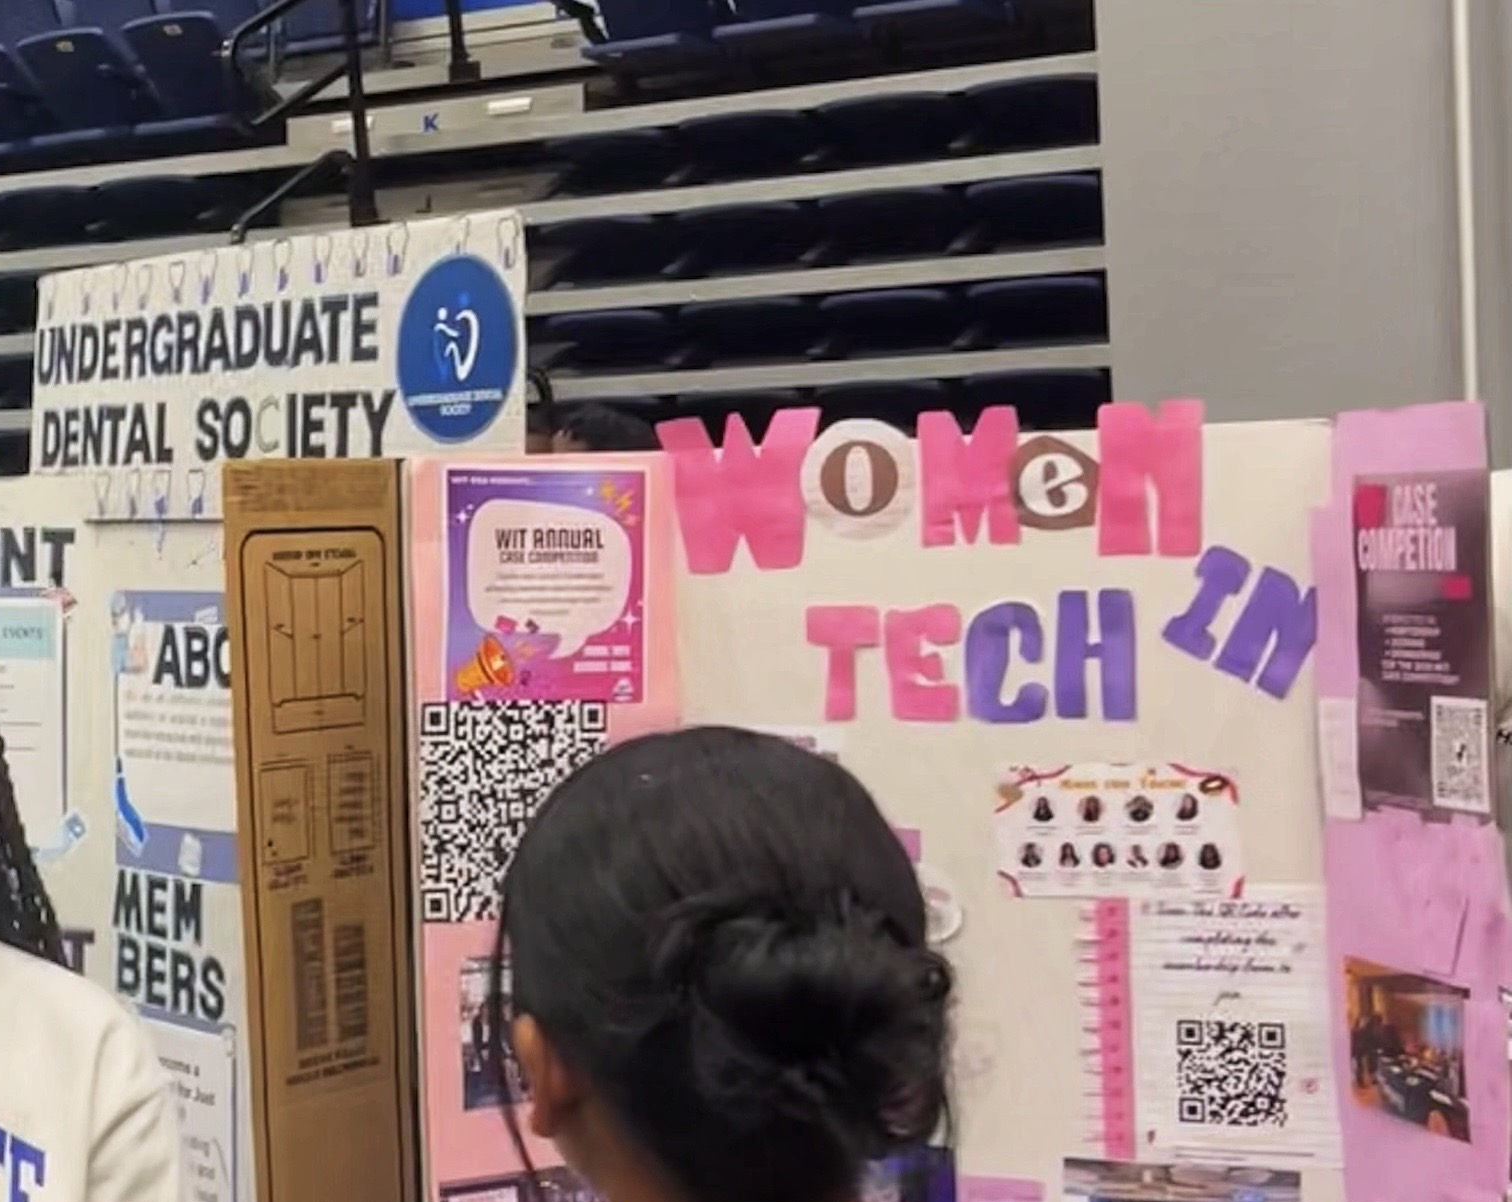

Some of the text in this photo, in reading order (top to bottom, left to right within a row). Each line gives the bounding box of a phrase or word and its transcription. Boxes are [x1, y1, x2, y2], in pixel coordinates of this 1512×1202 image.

[422, 113, 440, 133] K
[37, 293, 379, 385] UNDERGRADUATE
[41, 389, 396, 468] DENTAL SOCIETY
[495, 528, 528, 549] WIT
[805, 588, 1138, 724] TECH
[1162, 545, 1318, 701] IN
[112, 868, 204, 946] MEM
[116, 933, 226, 1022] BERS
